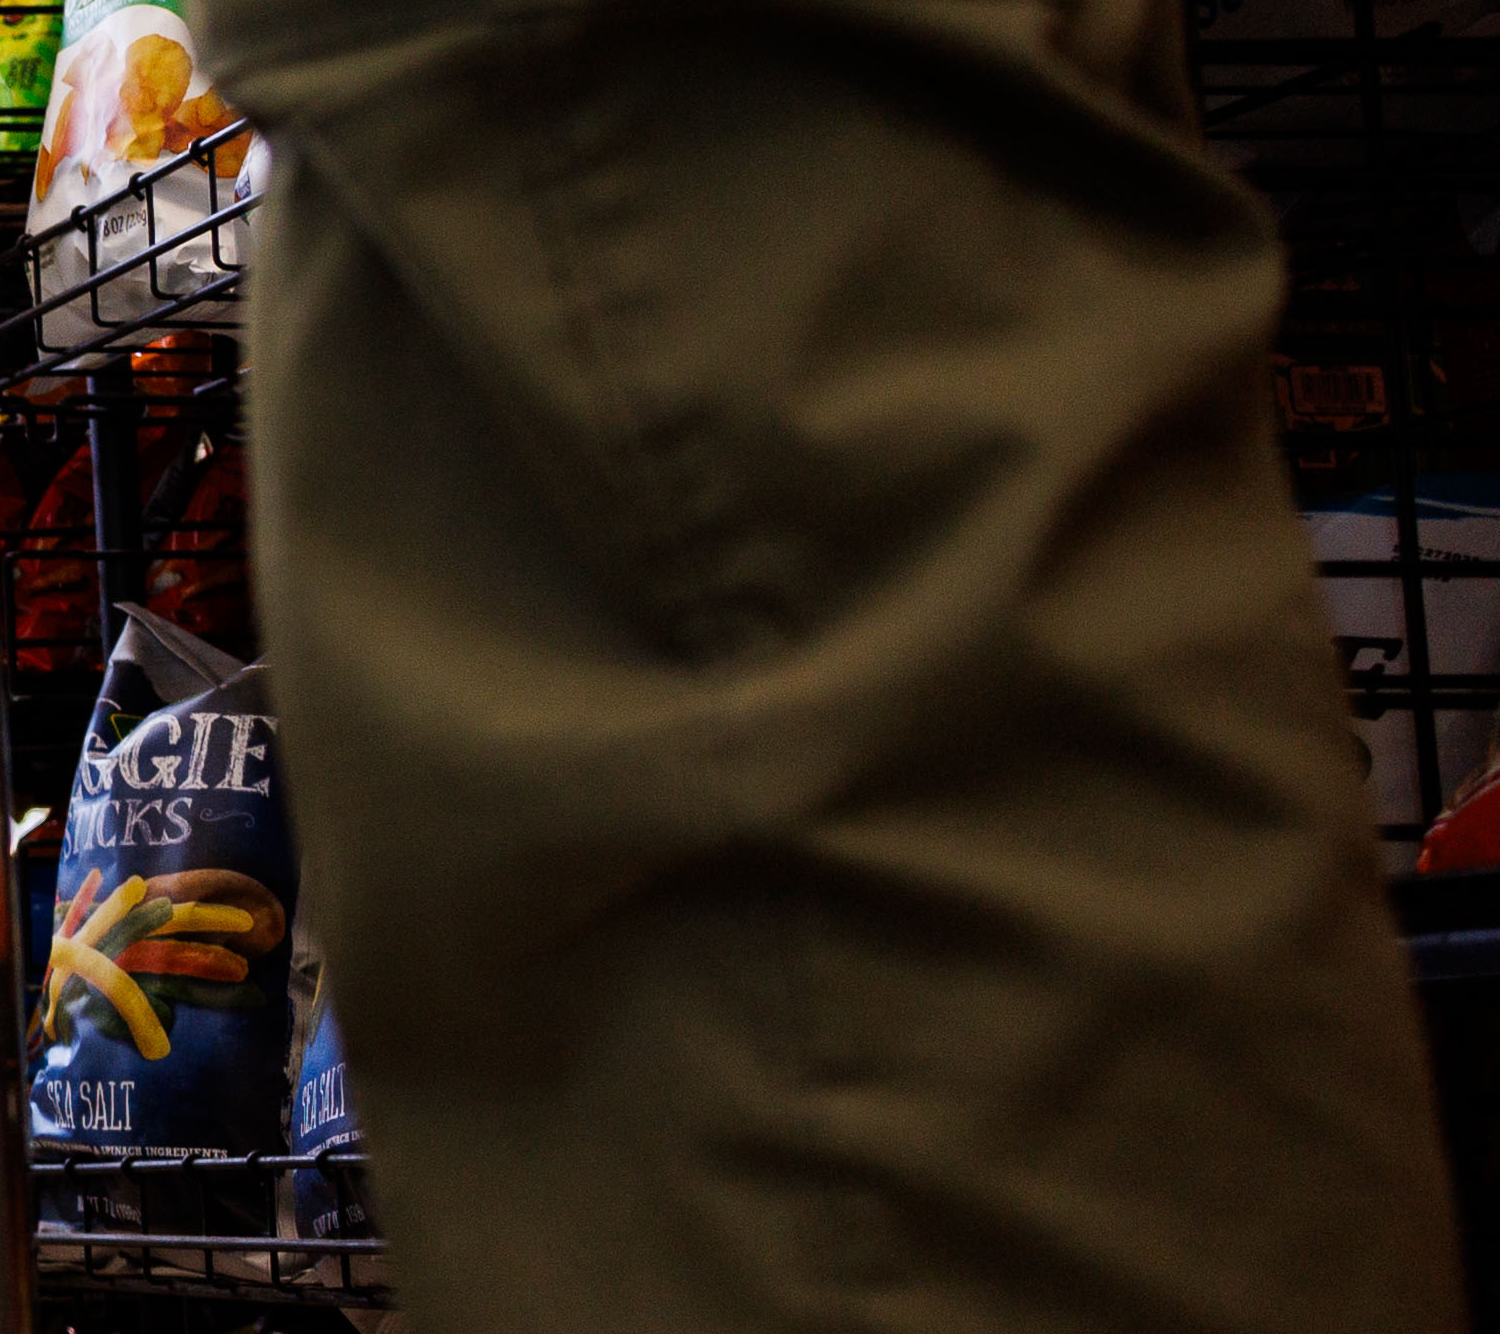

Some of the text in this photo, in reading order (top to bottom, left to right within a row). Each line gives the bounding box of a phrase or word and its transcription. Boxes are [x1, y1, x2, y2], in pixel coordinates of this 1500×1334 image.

[72, 712, 278, 801] GGIE
[63, 796, 193, 860] STICKS
[46, 1080, 135, 1132] SEA SALT
[299, 1062, 347, 1139] SEA SALT
[145, 1145, 229, 1159] INGREDIENTS
